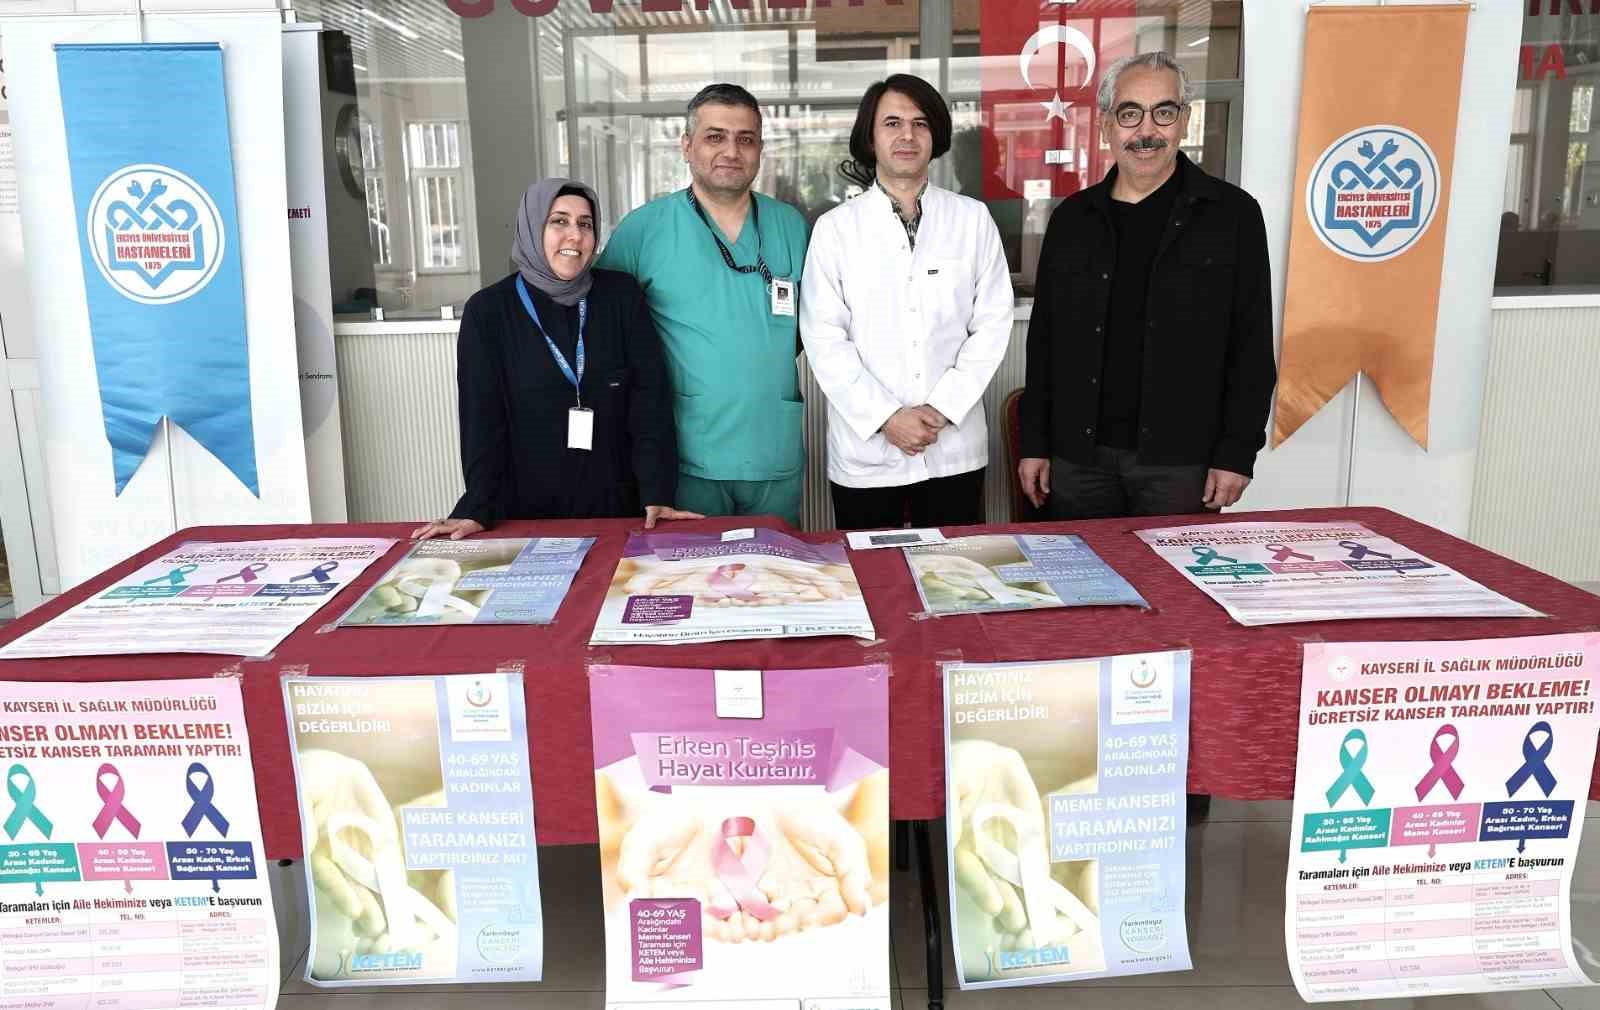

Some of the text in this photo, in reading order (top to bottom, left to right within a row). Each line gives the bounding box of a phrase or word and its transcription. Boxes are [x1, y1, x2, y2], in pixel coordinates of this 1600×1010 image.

[1336, 203, 1410, 218] HASTANELERİ
[117, 244, 191, 259] HASTANELERİ
[1360, 654, 1584, 676] KAYSERİ İL SAĞLIK MÜDÜRLÜĞÜ
[955, 690, 999, 706] BİZİM
[1317, 680, 1591, 707] KANSER OLMAYI BEKLEME!
[4, 696, 217, 713] KAYSERİ İL SAĞLIK MÜDÜRLÜĞÜ
[297, 702, 341, 716] BİZİM
[955, 706, 1049, 724] DEĞERLİDİR!
[1309, 701, 1595, 725] ÜCRETSİZ KANSER TARAMANI YAPTIR!
[55, 724, 128, 741] OLMAYI
[134, 723, 232, 740] BEKLEME!
[299, 719, 393, 734] DEĞERLİDİR!
[657, 735, 816, 762] Erken Teşhis
[1105, 734, 1177, 749] 40-69 YAŞ
[41, 745, 102, 759] KANSER
[104, 744, 183, 758] TARAMANI
[185, 744, 243, 757] YAPTIR!
[448, 752, 519, 768] 40-69 YAŞ
[658, 760, 816, 781] Hayat Kurtarır.
[1104, 762, 1177, 777] KADINLAR
[450, 781, 521, 793] KADINLAR
[1054, 792, 1177, 813] MEME KANSERİ
[406, 810, 524, 825] MEME KANSERİ
[1055, 815, 1176, 837] TARAMANIZI
[410, 832, 527, 848] TARAMANIZI
[1298, 868, 1350, 881] Taramaları
[1352, 867, 1371, 880] için
[1372, 864, 1391, 877] Aile
[1393, 862, 1448, 876] Hekiminize
[1449, 862, 1472, 874] veya
[1517, 856, 1565, 870] başvurun
[52, 900, 71, 914] için
[73, 898, 92, 910] Aile
[94, 897, 147, 910] Hekiminize
[149, 898, 172, 909] veya
[217, 896, 263, 909] başvurun
[638, 909, 665, 918] 40-69
[639, 949, 666, 957] KETEM
